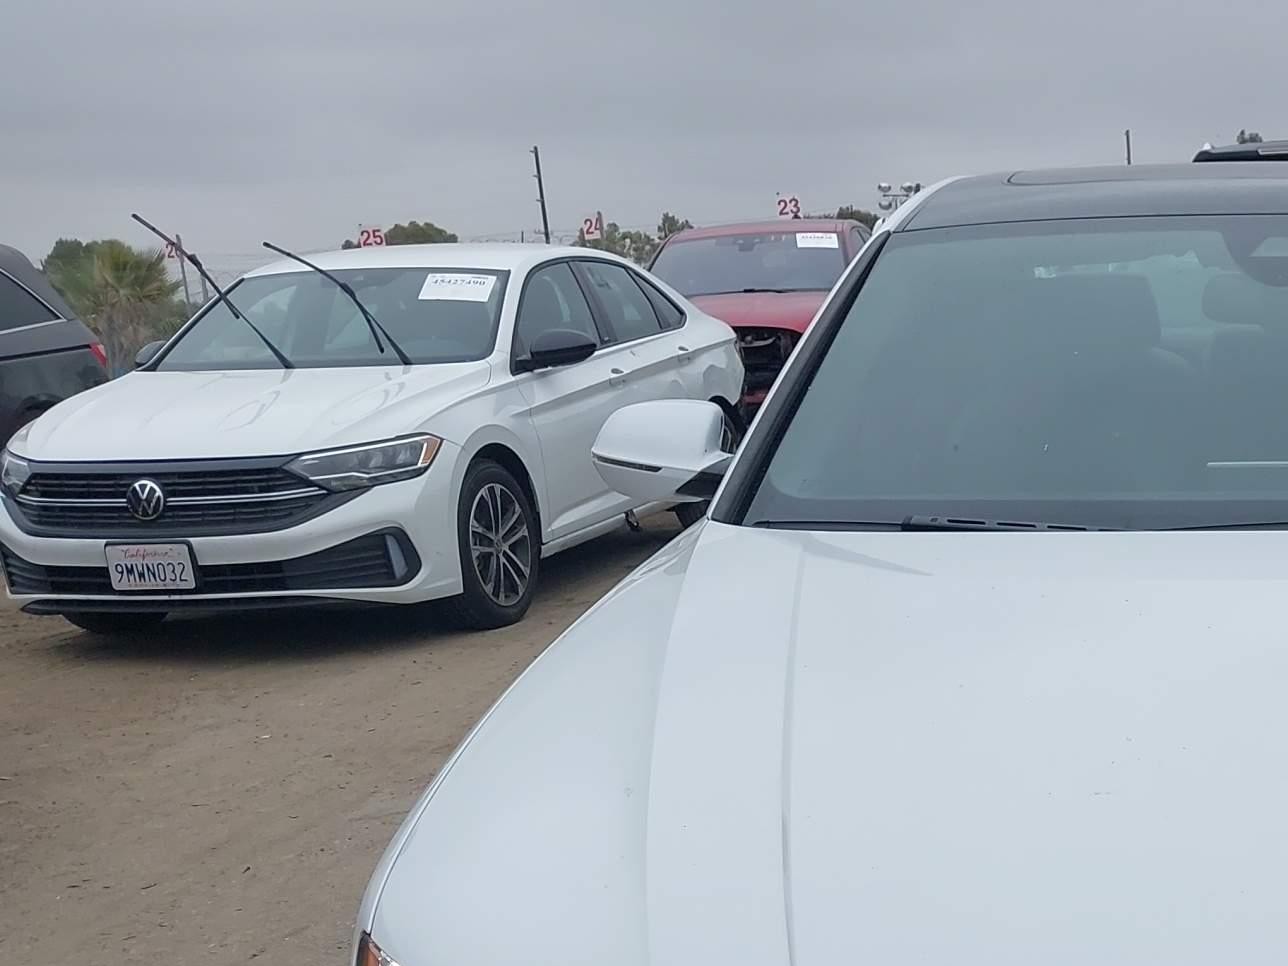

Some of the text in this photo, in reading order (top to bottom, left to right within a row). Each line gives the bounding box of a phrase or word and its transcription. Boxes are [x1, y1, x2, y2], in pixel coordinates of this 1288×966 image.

[778, 198, 800, 216] 23
[361, 229, 383, 246] 25
[114, 562, 188, 583] 9MWN032
